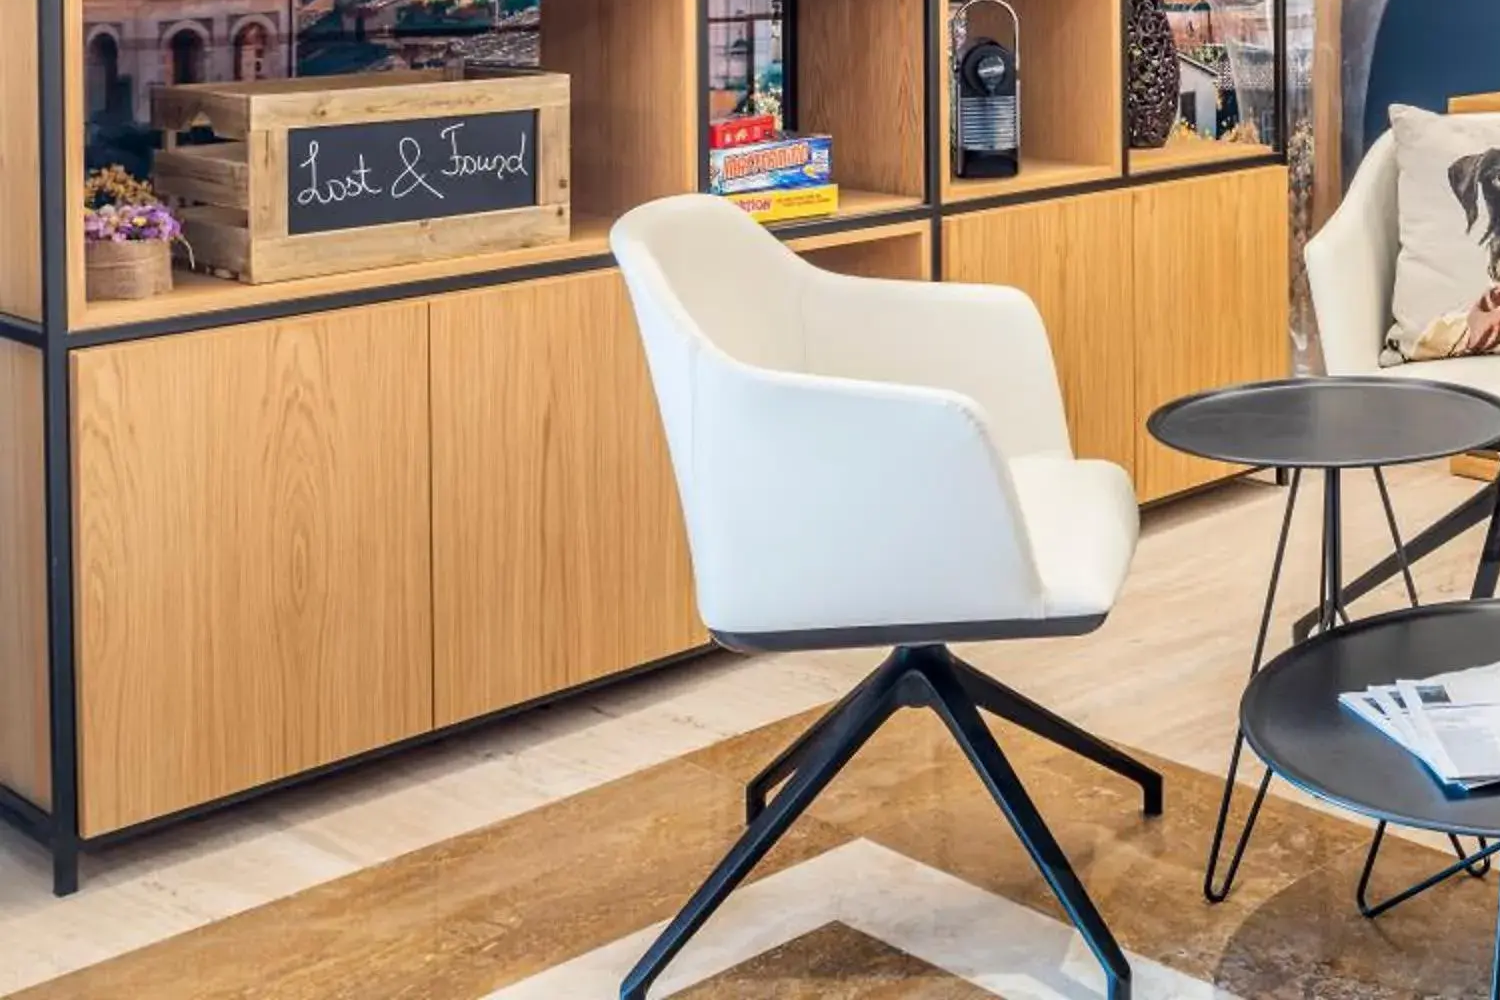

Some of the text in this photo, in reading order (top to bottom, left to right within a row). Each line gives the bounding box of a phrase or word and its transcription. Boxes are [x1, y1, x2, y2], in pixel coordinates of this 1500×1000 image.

[297, 121, 529, 205] Lost & Found
